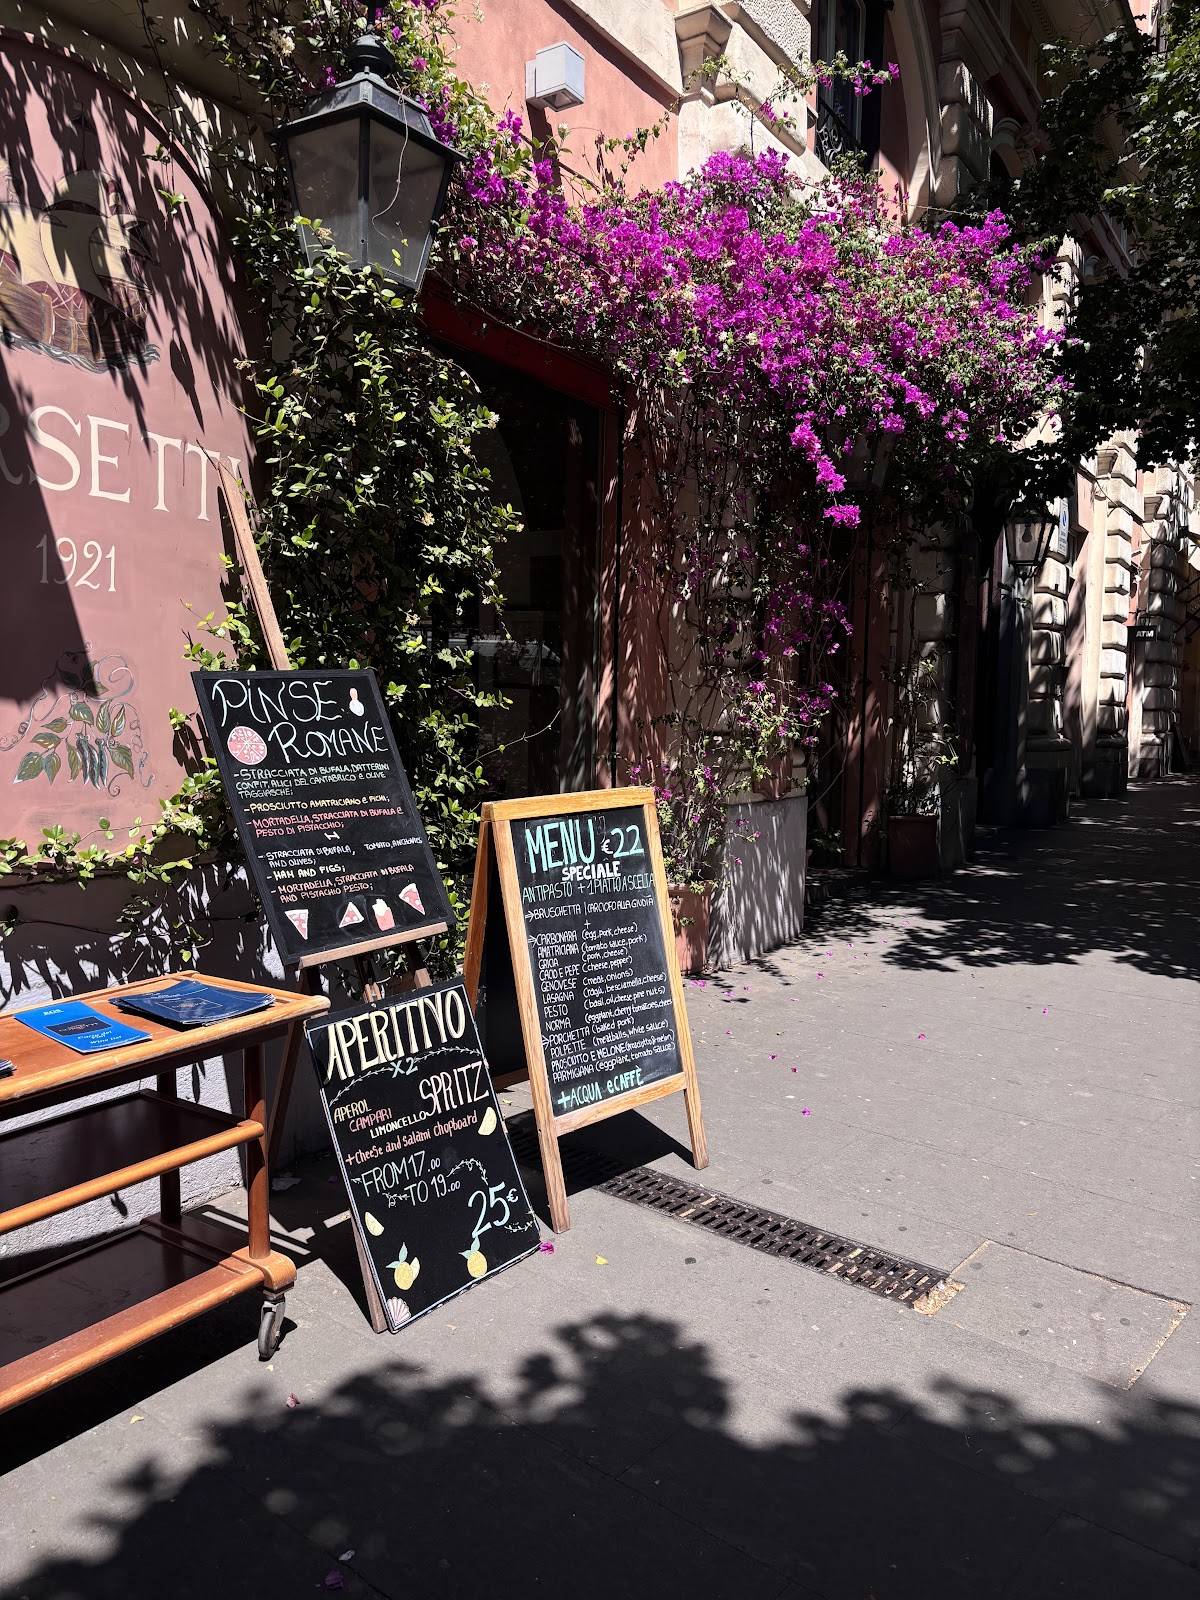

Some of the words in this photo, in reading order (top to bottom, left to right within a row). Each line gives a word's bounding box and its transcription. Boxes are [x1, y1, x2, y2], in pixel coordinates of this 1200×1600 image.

[35, 534, 117, 592] 1921
[268, 721, 388, 763] ROMANE
[271, 780, 292, 788] ALICI
[294, 778, 309, 786] DEL
[310, 774, 356, 785] CANTABRICO
[369, 808, 396, 816] BUFALA
[256, 828, 284, 838] PESTO
[266, 848, 315, 860] STRACCIATA
[525, 819, 595, 874] MENU
[269, 860, 287, 868] AND
[562, 861, 622, 881] SPECIALE
[273, 870, 295, 881] HAM
[298, 868, 317, 878] AND
[280, 894, 298, 903] AND
[300, 888, 341, 899] PISTACHIO
[523, 882, 572, 904] ANTIPASTO
[534, 904, 582, 920] BRUSCHETTA
[536, 930, 578, 946] CARBONARA
[538, 943, 579, 958] AMATRICIANA
[538, 958, 559, 970] GRICIA
[540, 969, 558, 981] CACIO
[559, 968, 564, 978] E
[564, 964, 580, 976] PEPE
[541, 978, 578, 992] GENOVESE
[542, 991, 574, 1004] LASAGNA
[544, 1004, 568, 1018] PESTO
[545, 1017, 572, 1031] NORMA
[324, 990, 466, 1085] APERITIVO
[549, 1026, 590, 1046] PORCHETTA
[550, 1039, 586, 1058] POLPETTE
[590, 1050, 596, 1061] E
[552, 1064, 594, 1084] PARMIGIANA
[419, 1060, 490, 1116] SPRITZ
[334, 1099, 372, 1124] APEROL
[348, 1108, 392, 1132] CAMPARI
[370, 1111, 427, 1138] LIMONCELLO
[386, 1133, 402, 1152] and
[361, 1157, 410, 1197] FROM
[404, 1180, 428, 1206] TO
